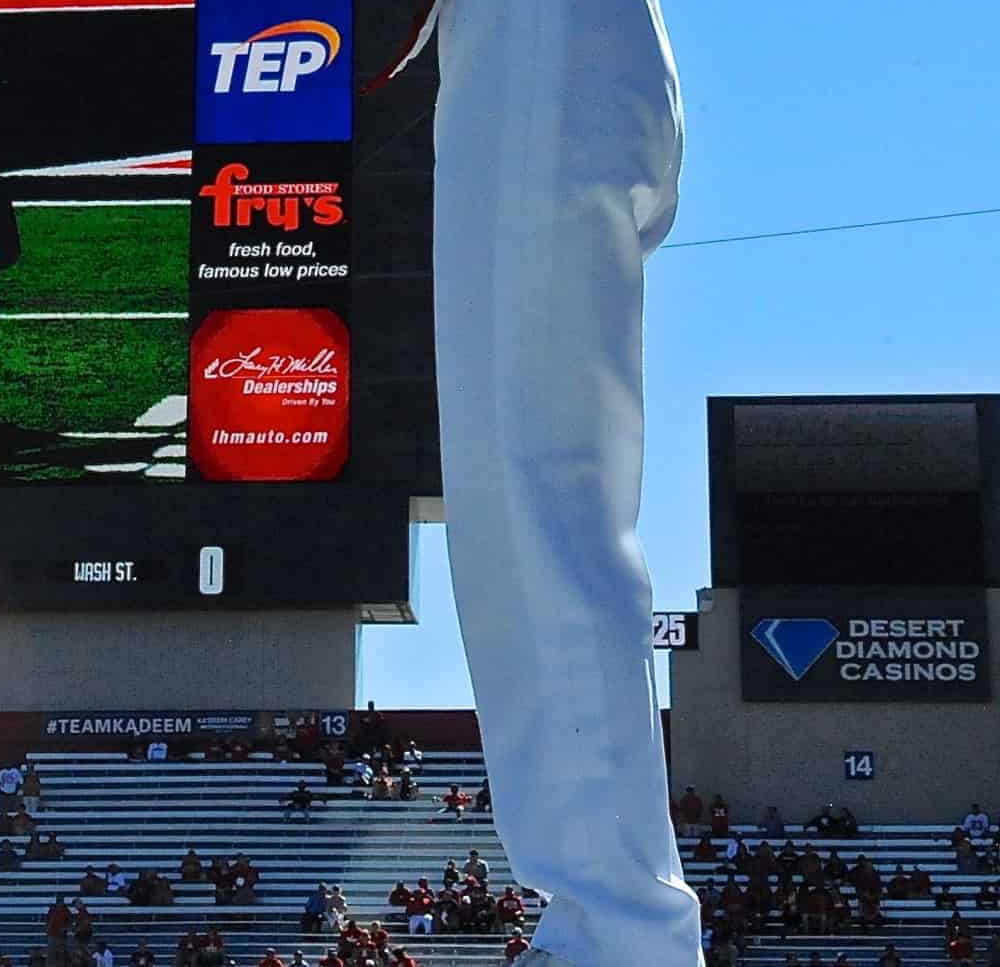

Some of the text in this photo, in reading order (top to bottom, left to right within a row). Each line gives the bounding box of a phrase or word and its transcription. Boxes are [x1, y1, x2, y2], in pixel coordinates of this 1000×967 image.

[210, 40, 327, 93] TEP
[199, 163, 344, 231] fry's
[234, 183, 333, 196] FOOD STORES
[229, 241, 317, 258] fresh food,
[199, 262, 348, 280] famous low prices
[243, 378, 337, 395] Dealerships
[212, 429, 329, 445] lhmauto.com
[74, 561, 137, 582] WASH ST.
[199, 546, 224, 595] 0
[849, 619, 965, 637] DESERT
[835, 641, 979, 659] DIAMOND
[839, 663, 976, 681] CASINOS
[46, 717, 193, 735] #TEAMKADEEM
[321, 715, 347, 735] 13
[844, 755, 873, 777] 14
